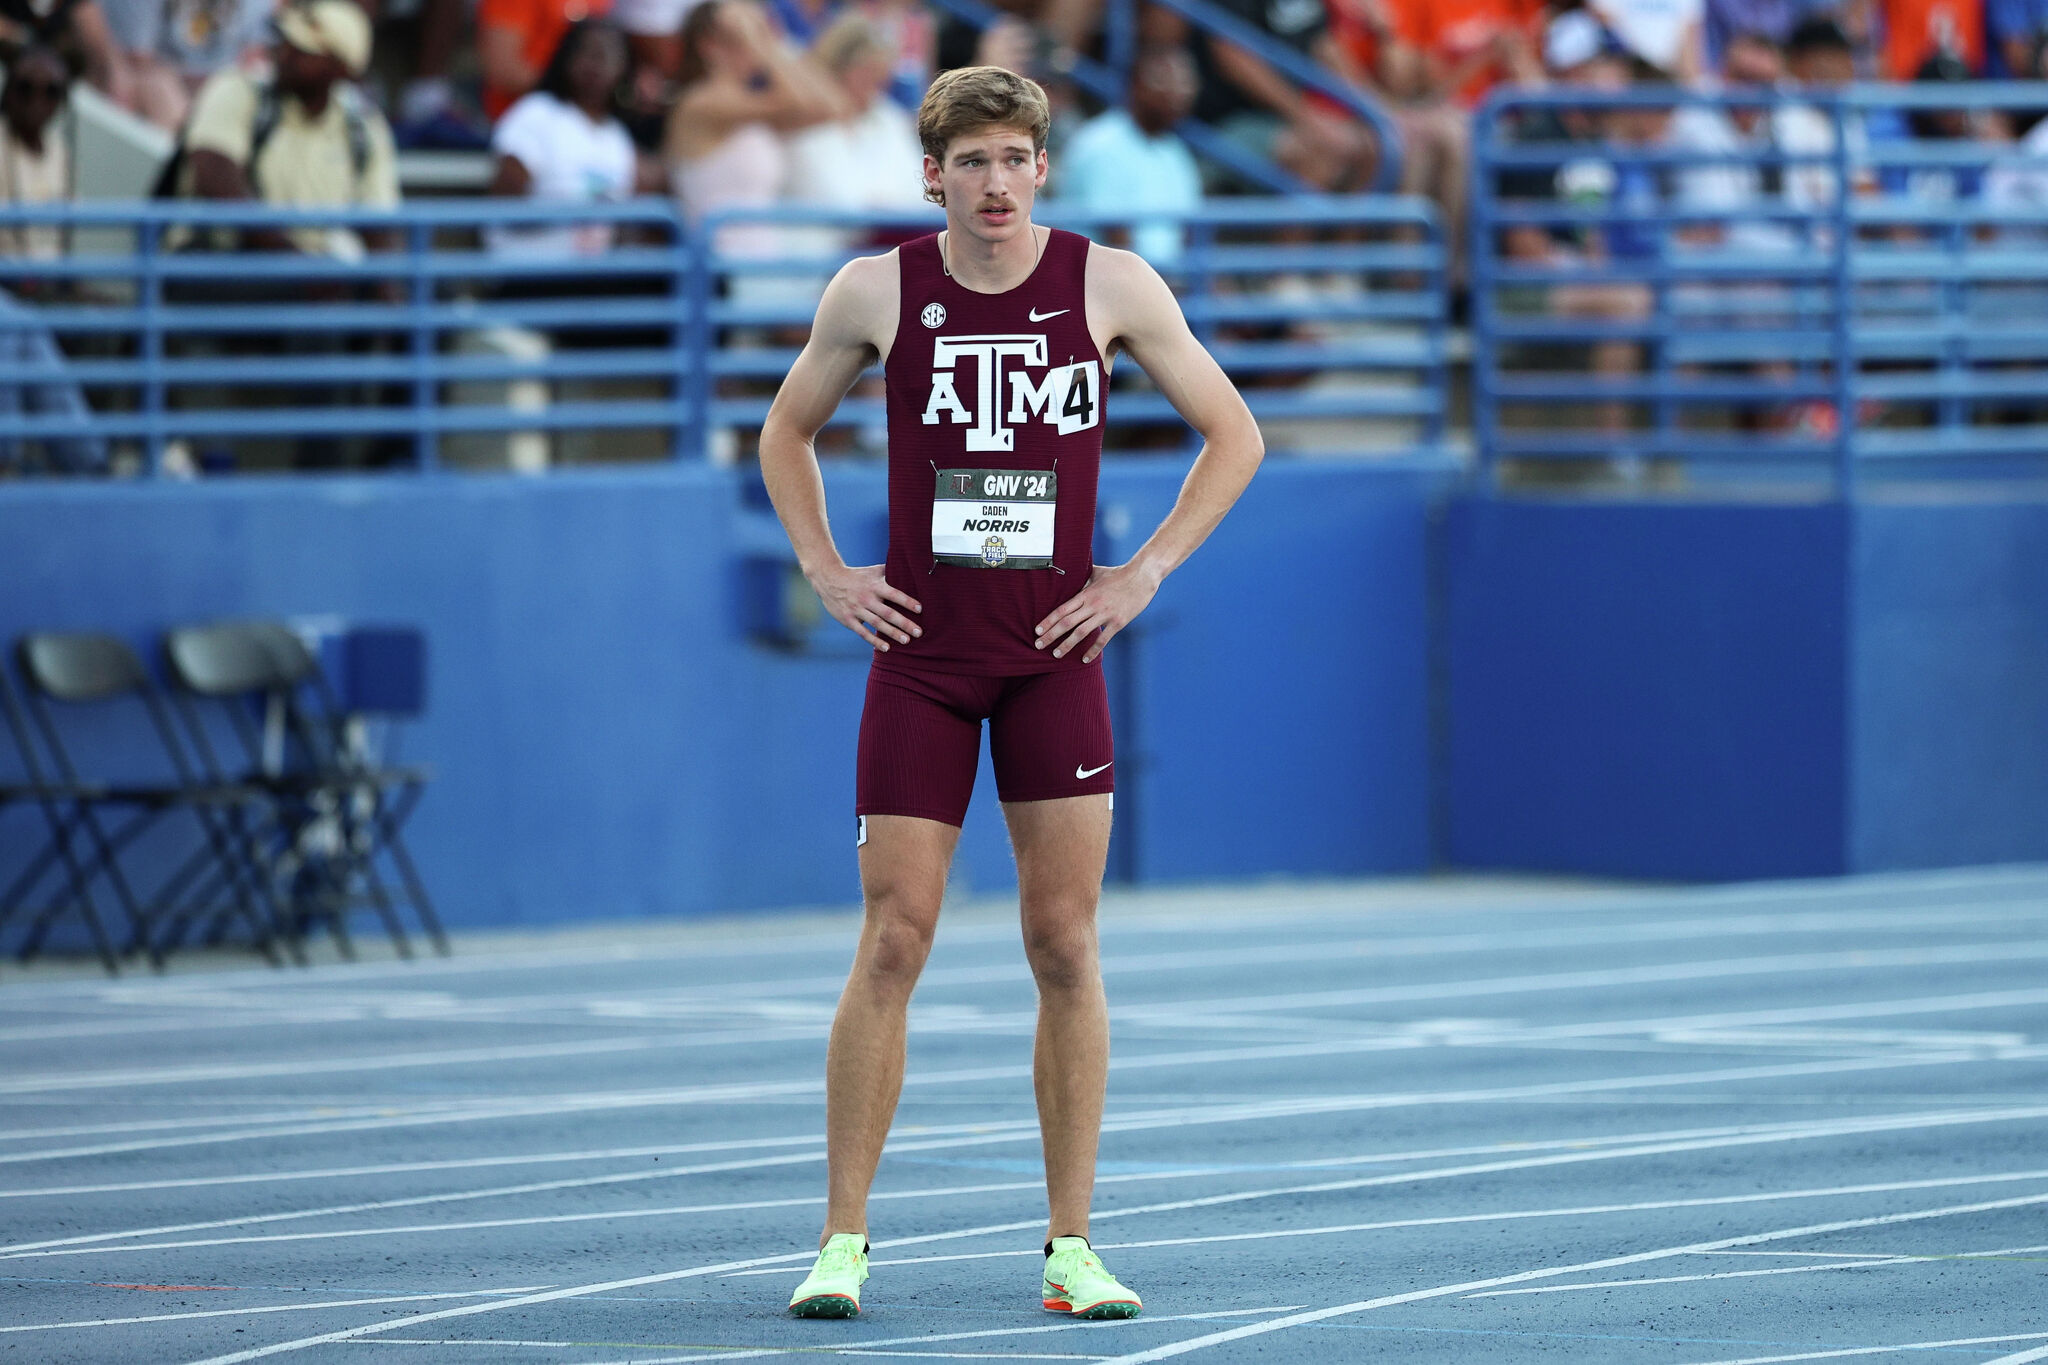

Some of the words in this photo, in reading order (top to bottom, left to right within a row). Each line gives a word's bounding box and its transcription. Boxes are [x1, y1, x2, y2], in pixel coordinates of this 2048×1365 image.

[922, 304, 945, 327] SEC
[1062, 367, 1093, 426] 4
[983, 474, 1021, 497] GNV
[1023, 475, 1048, 497] '24
[982, 505, 1008, 516] CADEN
[962, 519, 1031, 532] NORRIS
